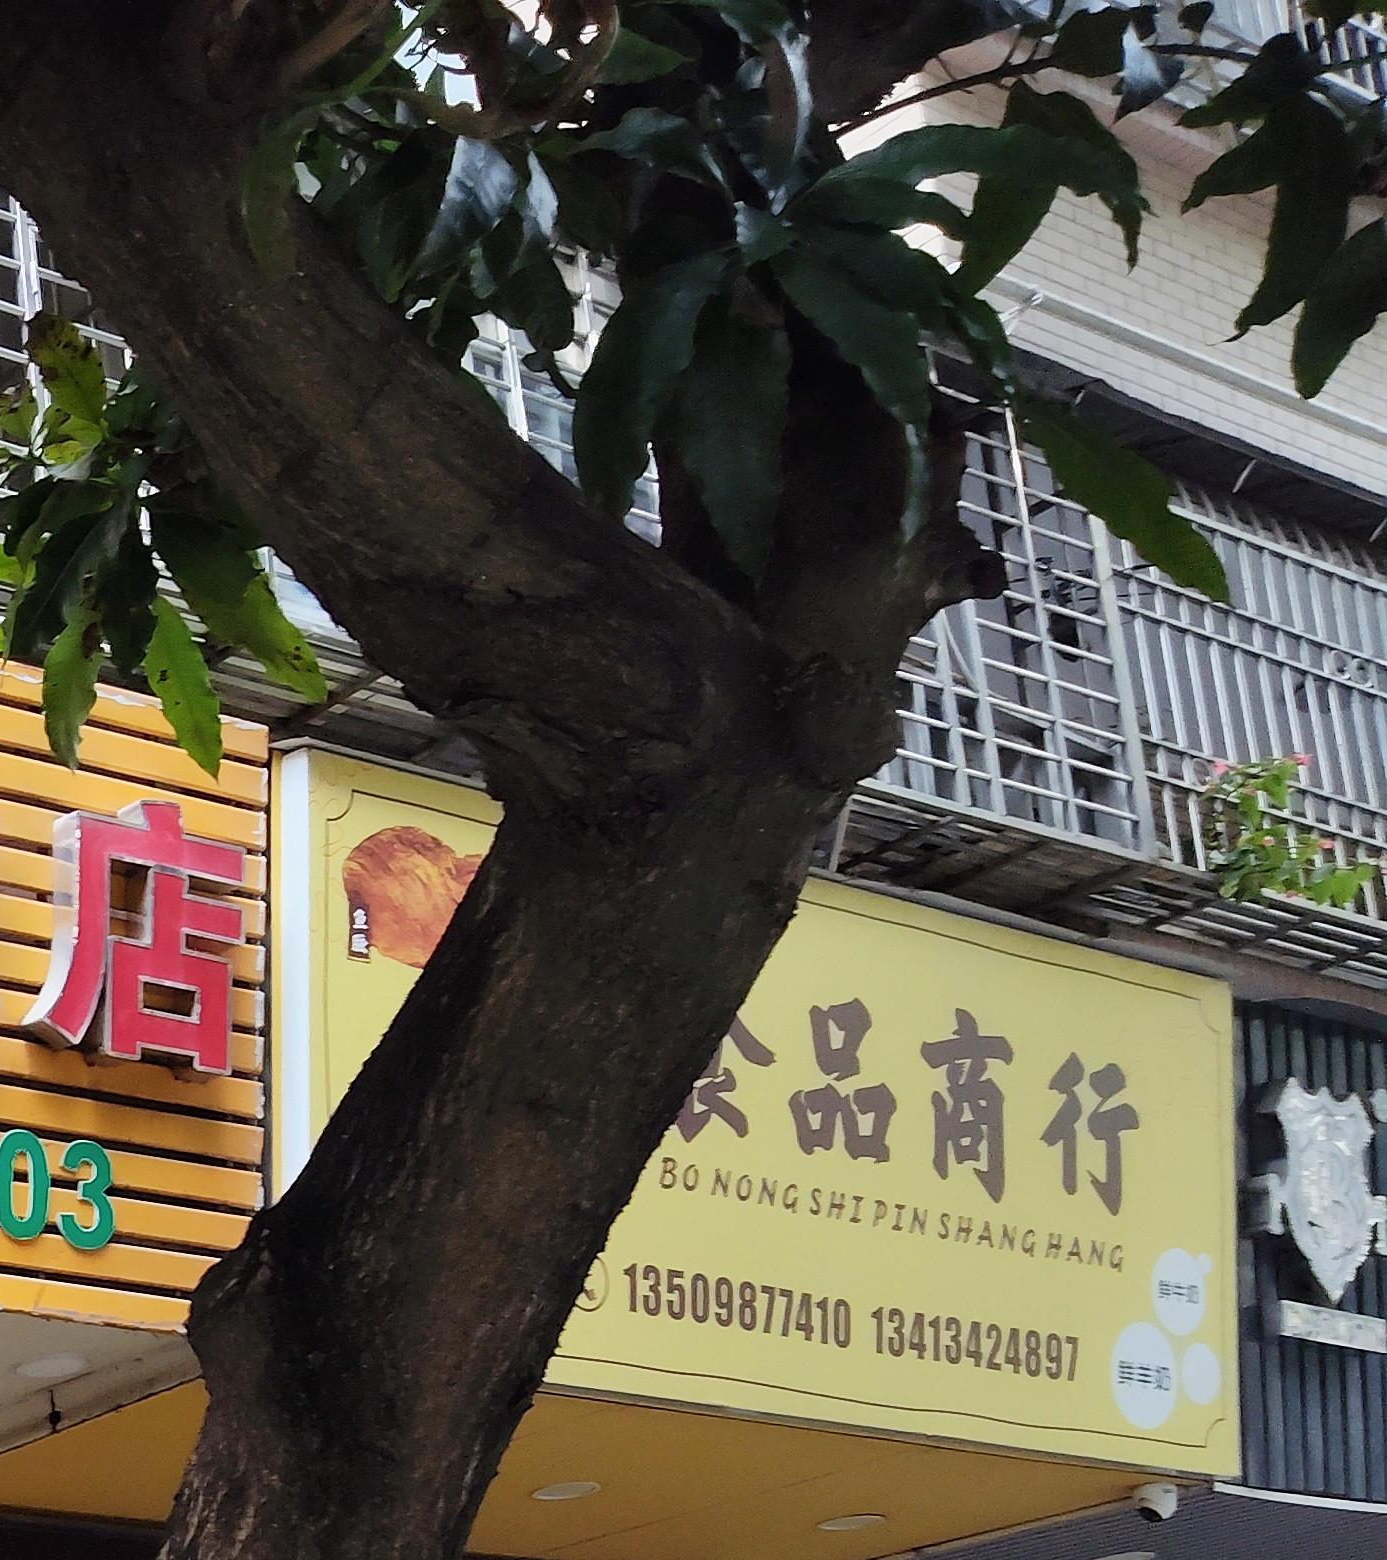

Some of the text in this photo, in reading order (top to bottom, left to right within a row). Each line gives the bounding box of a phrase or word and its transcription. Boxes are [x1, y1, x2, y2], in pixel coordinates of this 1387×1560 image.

[659, 1156, 1125, 1273] BO NONG SHI PIN SHANG HANG
[623, 1262, 1079, 1382] 13509877410 13413424897
